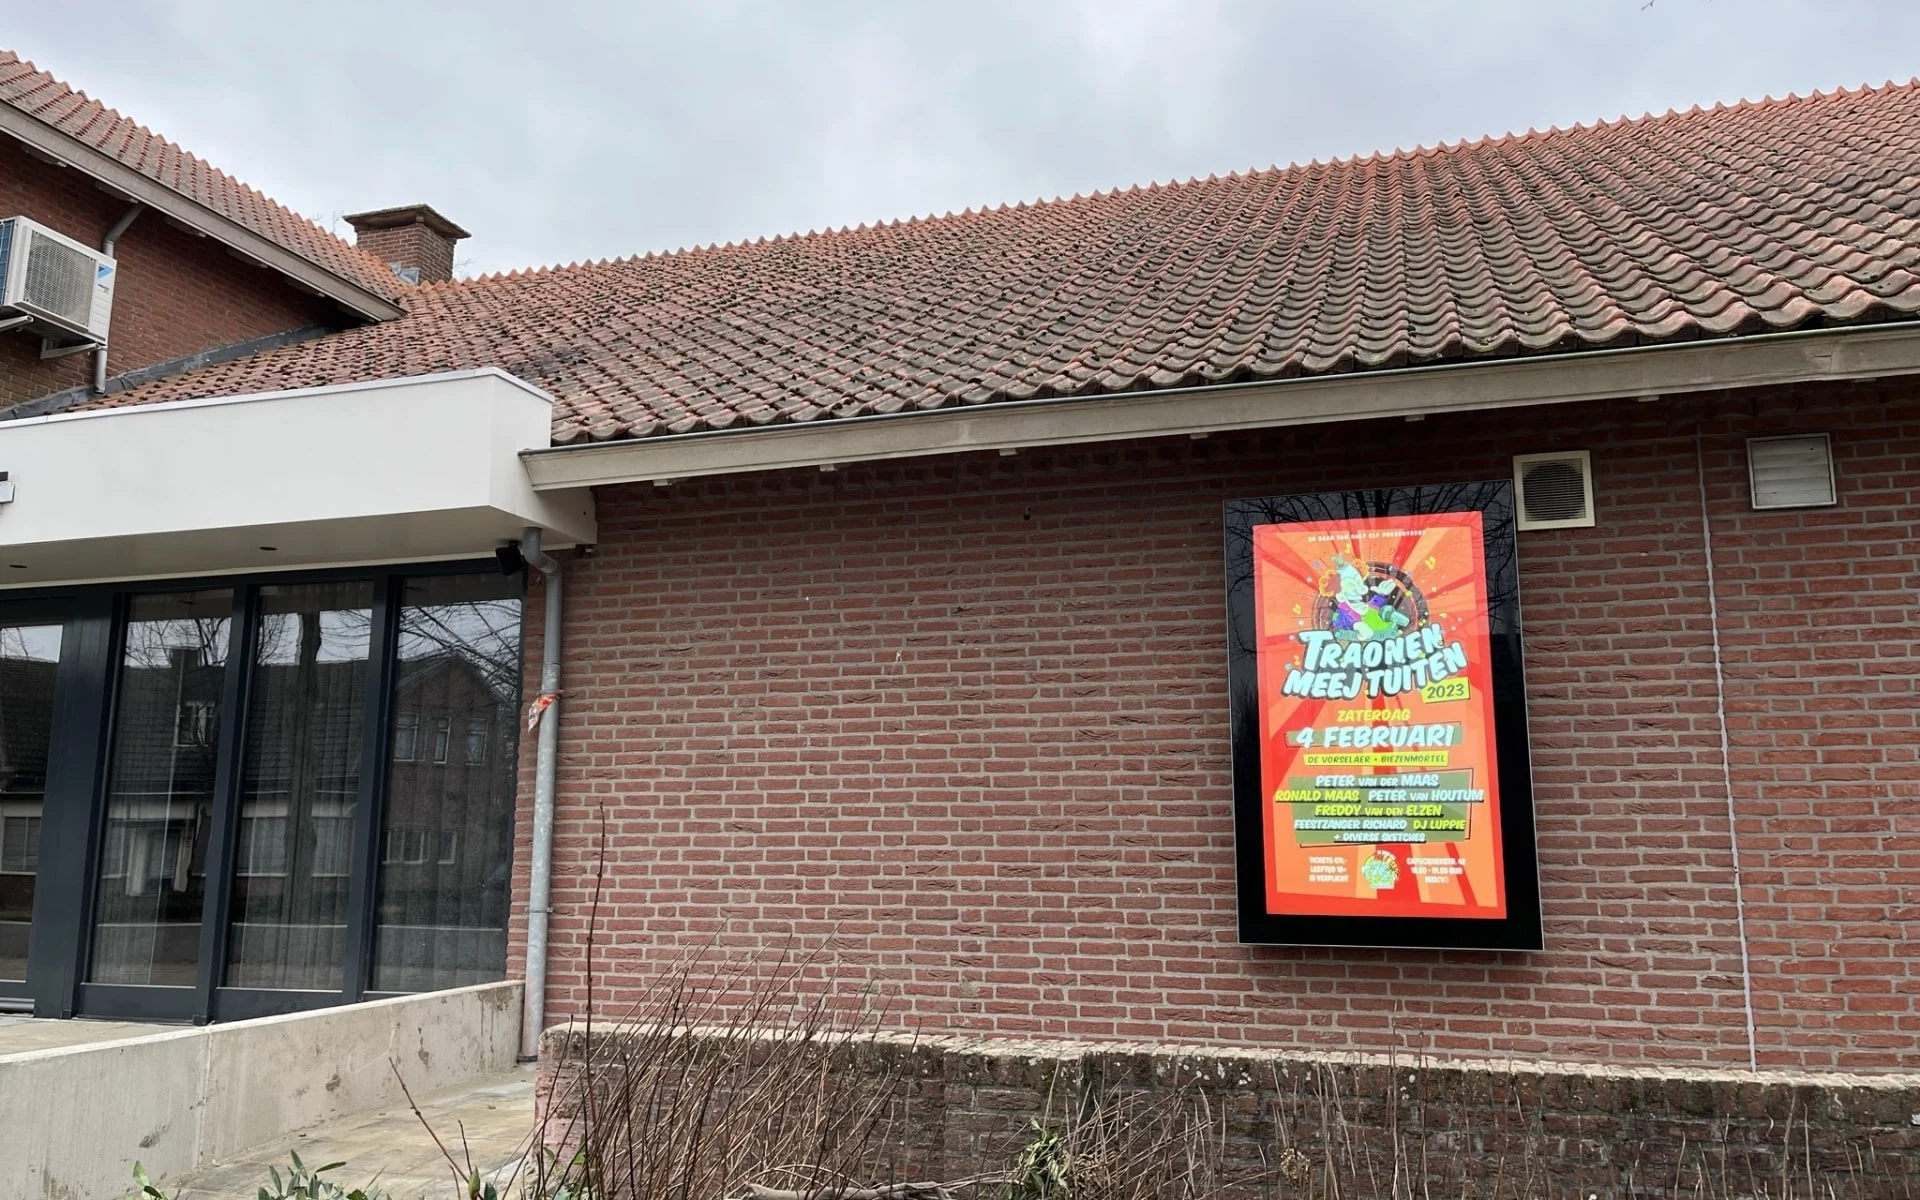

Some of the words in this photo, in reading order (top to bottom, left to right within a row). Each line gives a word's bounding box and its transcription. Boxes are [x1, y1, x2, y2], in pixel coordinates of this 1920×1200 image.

[1298, 623, 1445, 672] TRAONEN
[1283, 668, 1362, 699] MEEJ
[1366, 641, 1468, 698] TUITEN
[1427, 682, 1465, 699] 2023
[1337, 708, 1411, 722] ZATERDAG
[1296, 726, 1314, 749] 4
[1324, 724, 1455, 749] FEBRUARI
[1307, 755, 1320, 764] DE
[1321, 755, 1371, 764] VORSELAER
[1381, 754, 1445, 763] BIEZENMORTEL
[1315, 774, 1355, 787] PETER
[1358, 777, 1377, 787] VAN
[1380, 777, 1399, 787] DER
[1401, 774, 1439, 787] MAAS
[1275, 790, 1321, 802] RONALD
[1324, 790, 1360, 802] MAAS
[1368, 789, 1407, 802] PETER
[1409, 792, 1429, 802] VAN
[1431, 788, 1485, 802] HOUTUM
[1315, 804, 1362, 816] FREDDY
[1364, 807, 1383, 817] VAN
[1385, 807, 1403, 816] DEN
[1406, 804, 1443, 816] ELZEN
[1294, 819, 1361, 830] FEESTZANGER
[1362, 819, 1407, 830] RICHARD
[1413, 819, 1428, 830] DJ
[1429, 819, 1466, 830] LUPPIE
[1343, 832, 1379, 842] DIVERSE
[1381, 832, 1426, 842] SKETCHES
